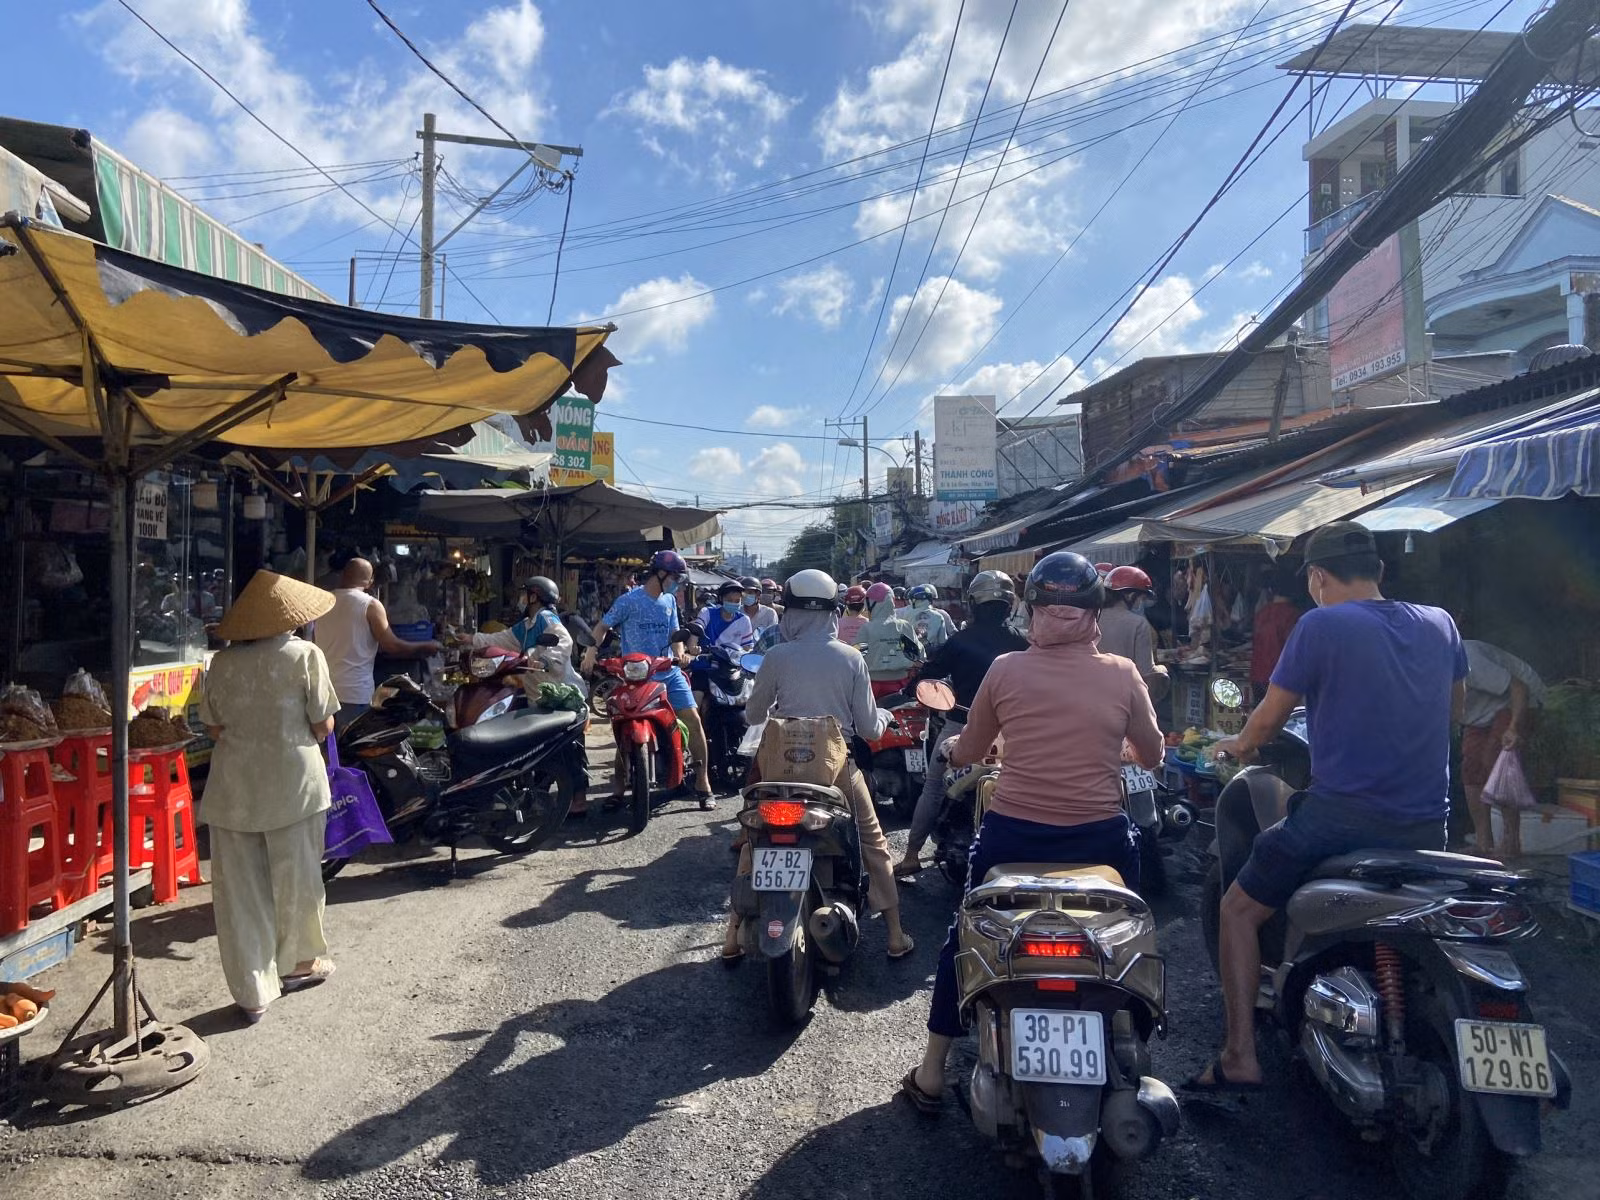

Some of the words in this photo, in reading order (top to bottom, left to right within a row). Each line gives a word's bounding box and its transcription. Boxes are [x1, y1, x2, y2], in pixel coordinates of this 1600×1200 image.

[1349, 365, 1368, 382] 0934
[1371, 351, 1402, 373] 193.955
[567, 455, 586, 468] 302
[139, 522, 158, 538] 100K
[1128, 775, 1154, 791] 3.09
[754, 870, 806, 889] 656.77
[1024, 1014, 1088, 1045] 38-P1
[1470, 1025, 1534, 1058] 50-N1
[1017, 1045, 1098, 1079] 530.99
[1466, 1056, 1549, 1091] 129.66
